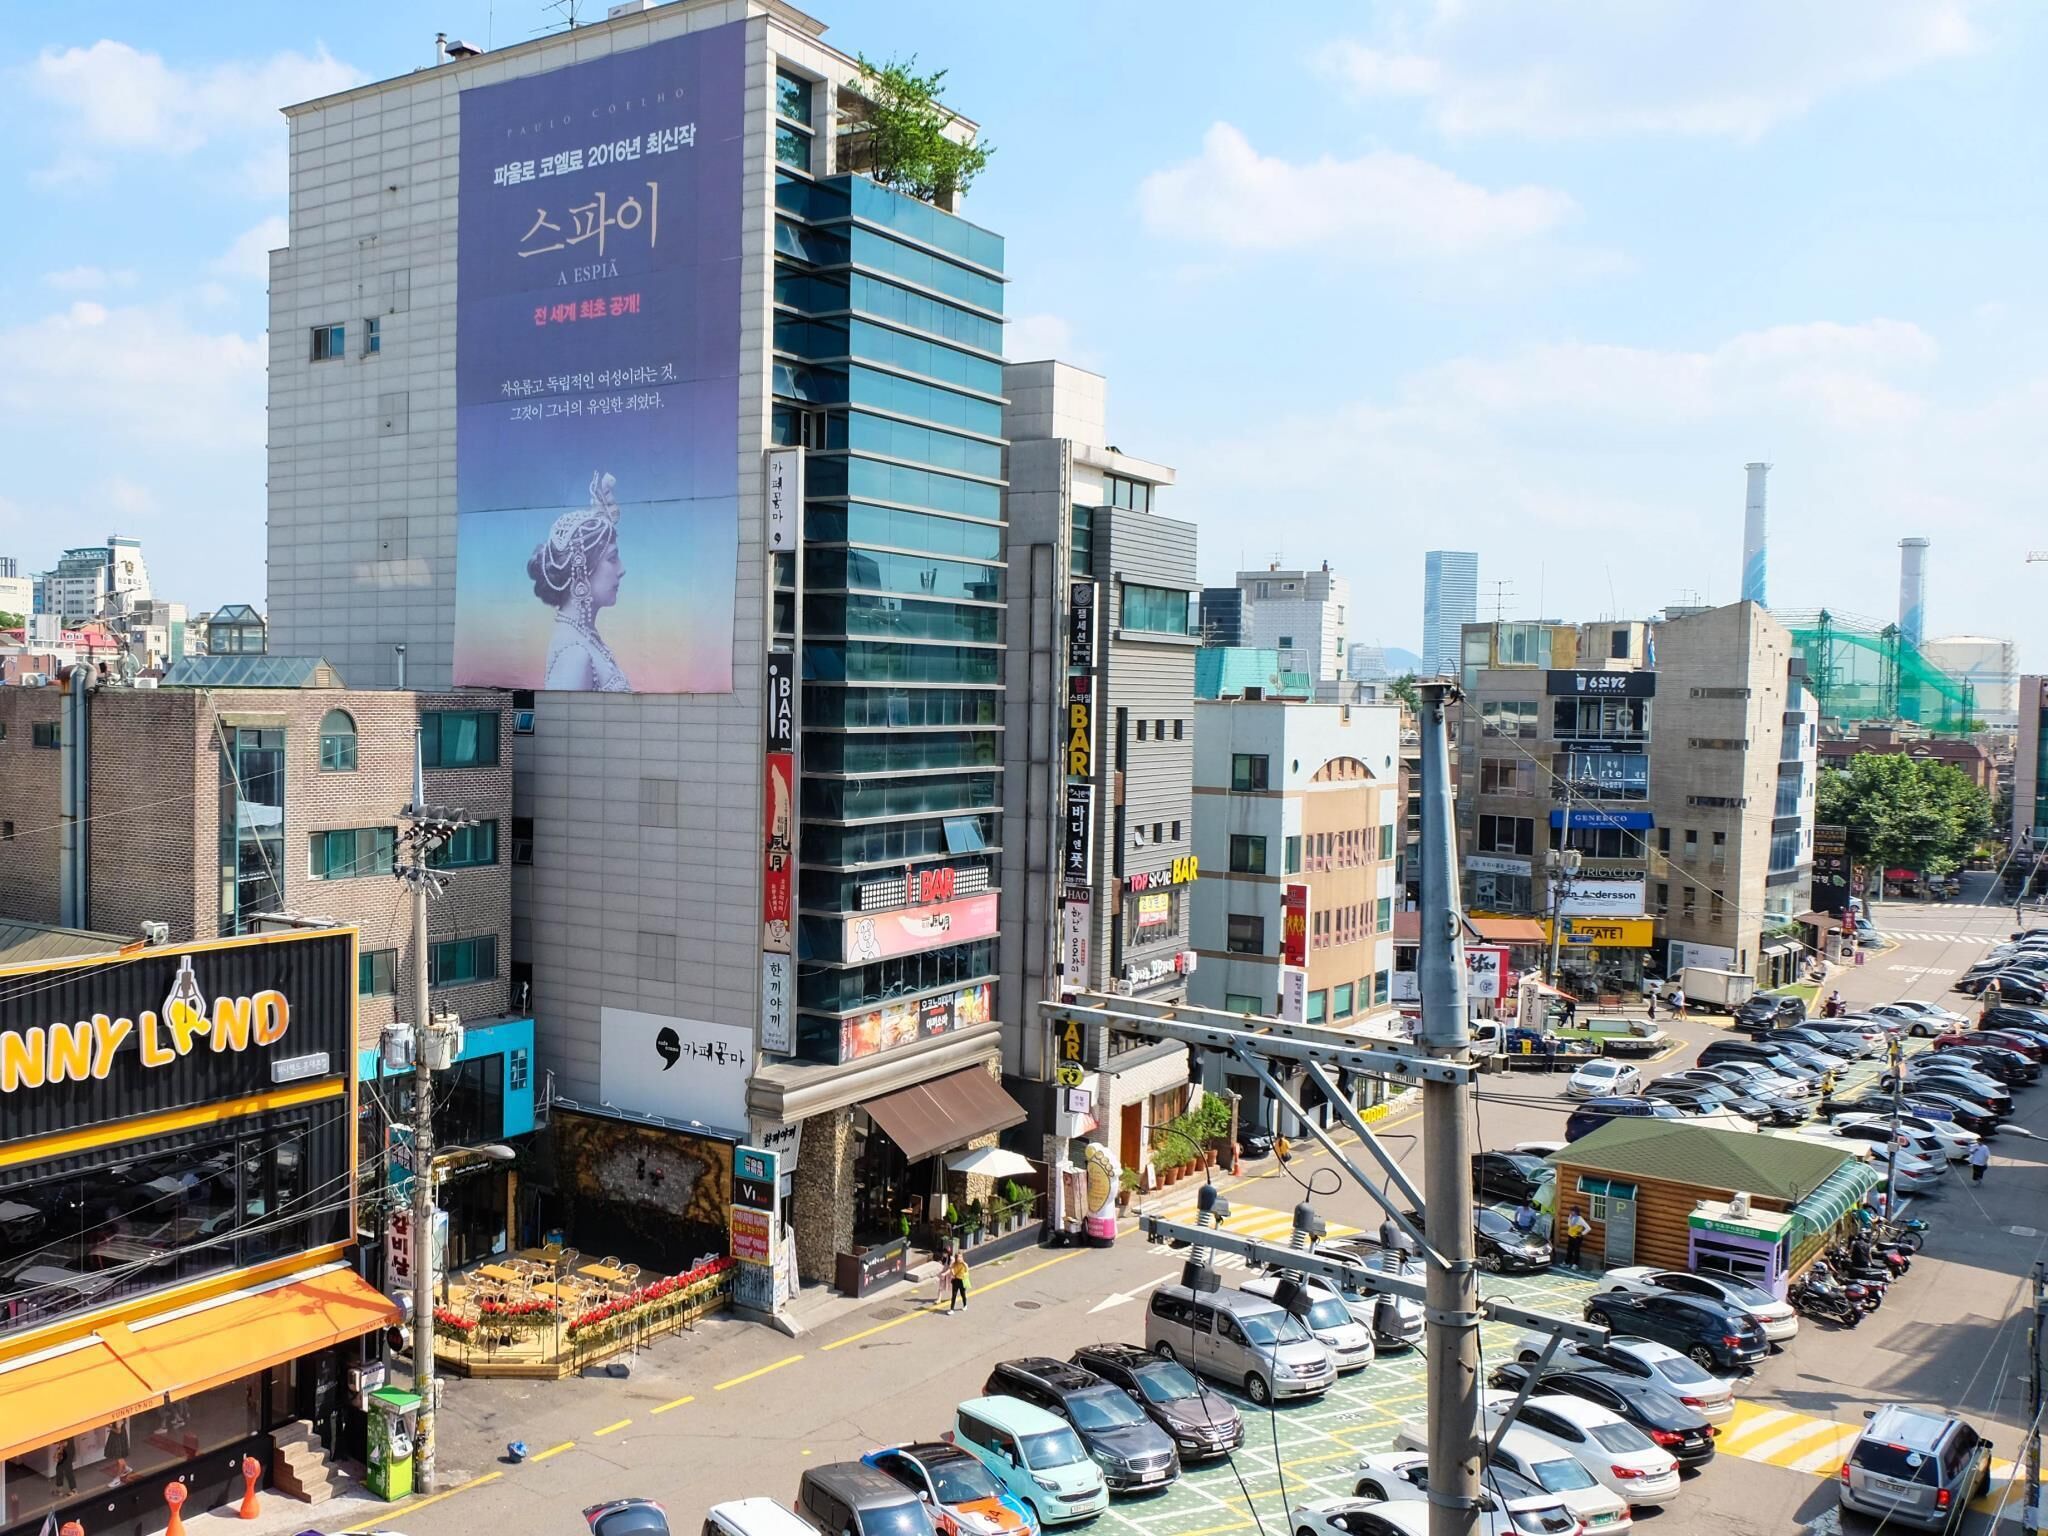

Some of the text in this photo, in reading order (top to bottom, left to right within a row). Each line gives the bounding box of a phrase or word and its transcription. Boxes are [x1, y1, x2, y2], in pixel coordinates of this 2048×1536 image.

[507, 88, 684, 137] PAULO COELHO
[494, 160, 536, 186] 파울로
[588, 136, 641, 168] 2016년
[646, 122, 697, 155] 최신작
[517, 181, 658, 258] 스파이
[557, 271, 568, 285] A
[534, 293, 641, 325] 전 세계 최초 공개!
[501, 379, 544, 396] 자유롭고
[547, 372, 594, 393] 독립적인
[598, 366, 657, 388] 여성이라는
[510, 404, 542, 421] 그것이
[546, 399, 582, 417] 그녀의
[586, 396, 622, 415] 유일한
[778, 677, 791, 739] BAR
[1068, 704, 1091, 776] BAR
[919, 867, 955, 902] BAR
[1130, 873, 1149, 892] TOP
[1172, 856, 1198, 884] BAR
[1067, 889, 1089, 900] HAO
[769, 962, 782, 1028] 한끼야끼
[1063, 1021, 1080, 1060] AR
[1616, 1202, 1626, 1213] P
